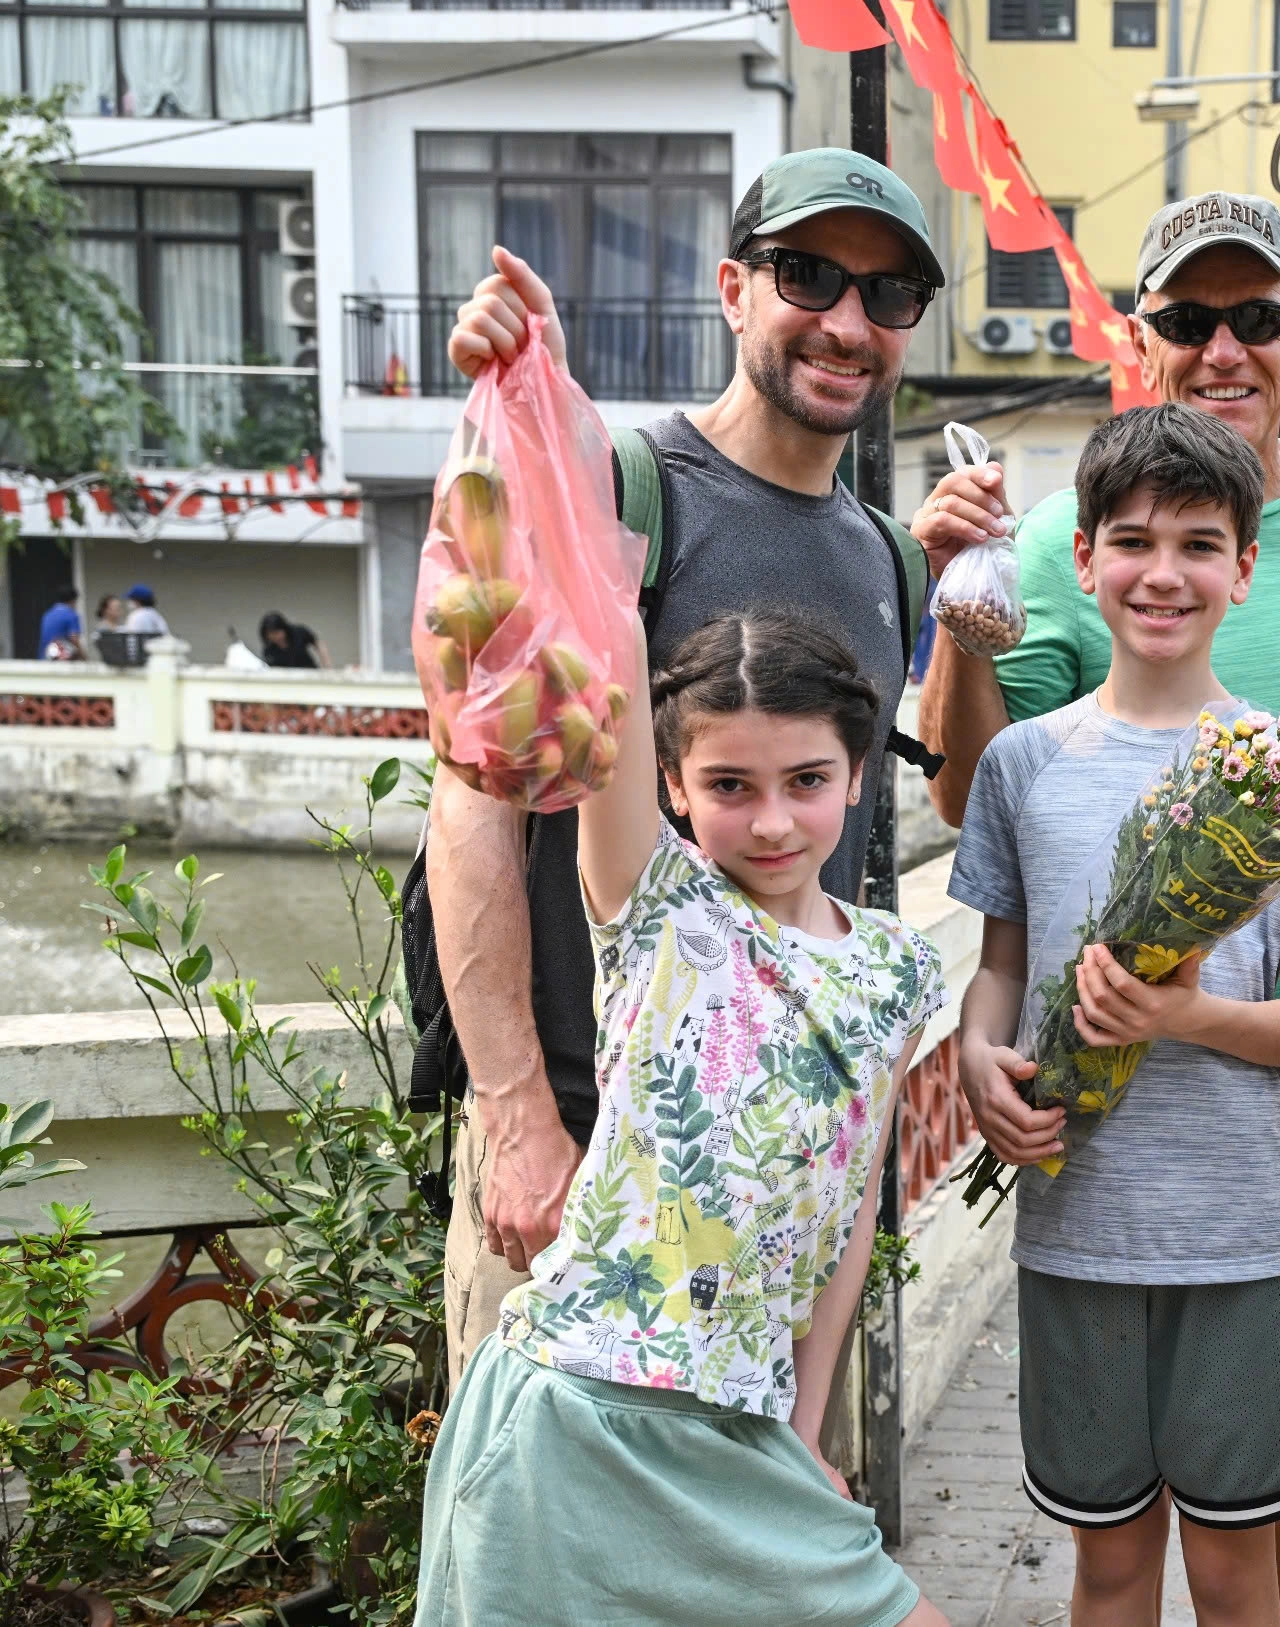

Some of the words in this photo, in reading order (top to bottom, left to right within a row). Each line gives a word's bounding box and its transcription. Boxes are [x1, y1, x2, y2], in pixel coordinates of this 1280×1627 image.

[845, 172, 884, 200] OR
[1161, 198, 1223, 250] COSTA
[1227, 200, 1275, 245] RICA
[1216, 224, 1240, 235] 1821
[1169, 879, 1228, 920] Hoa
